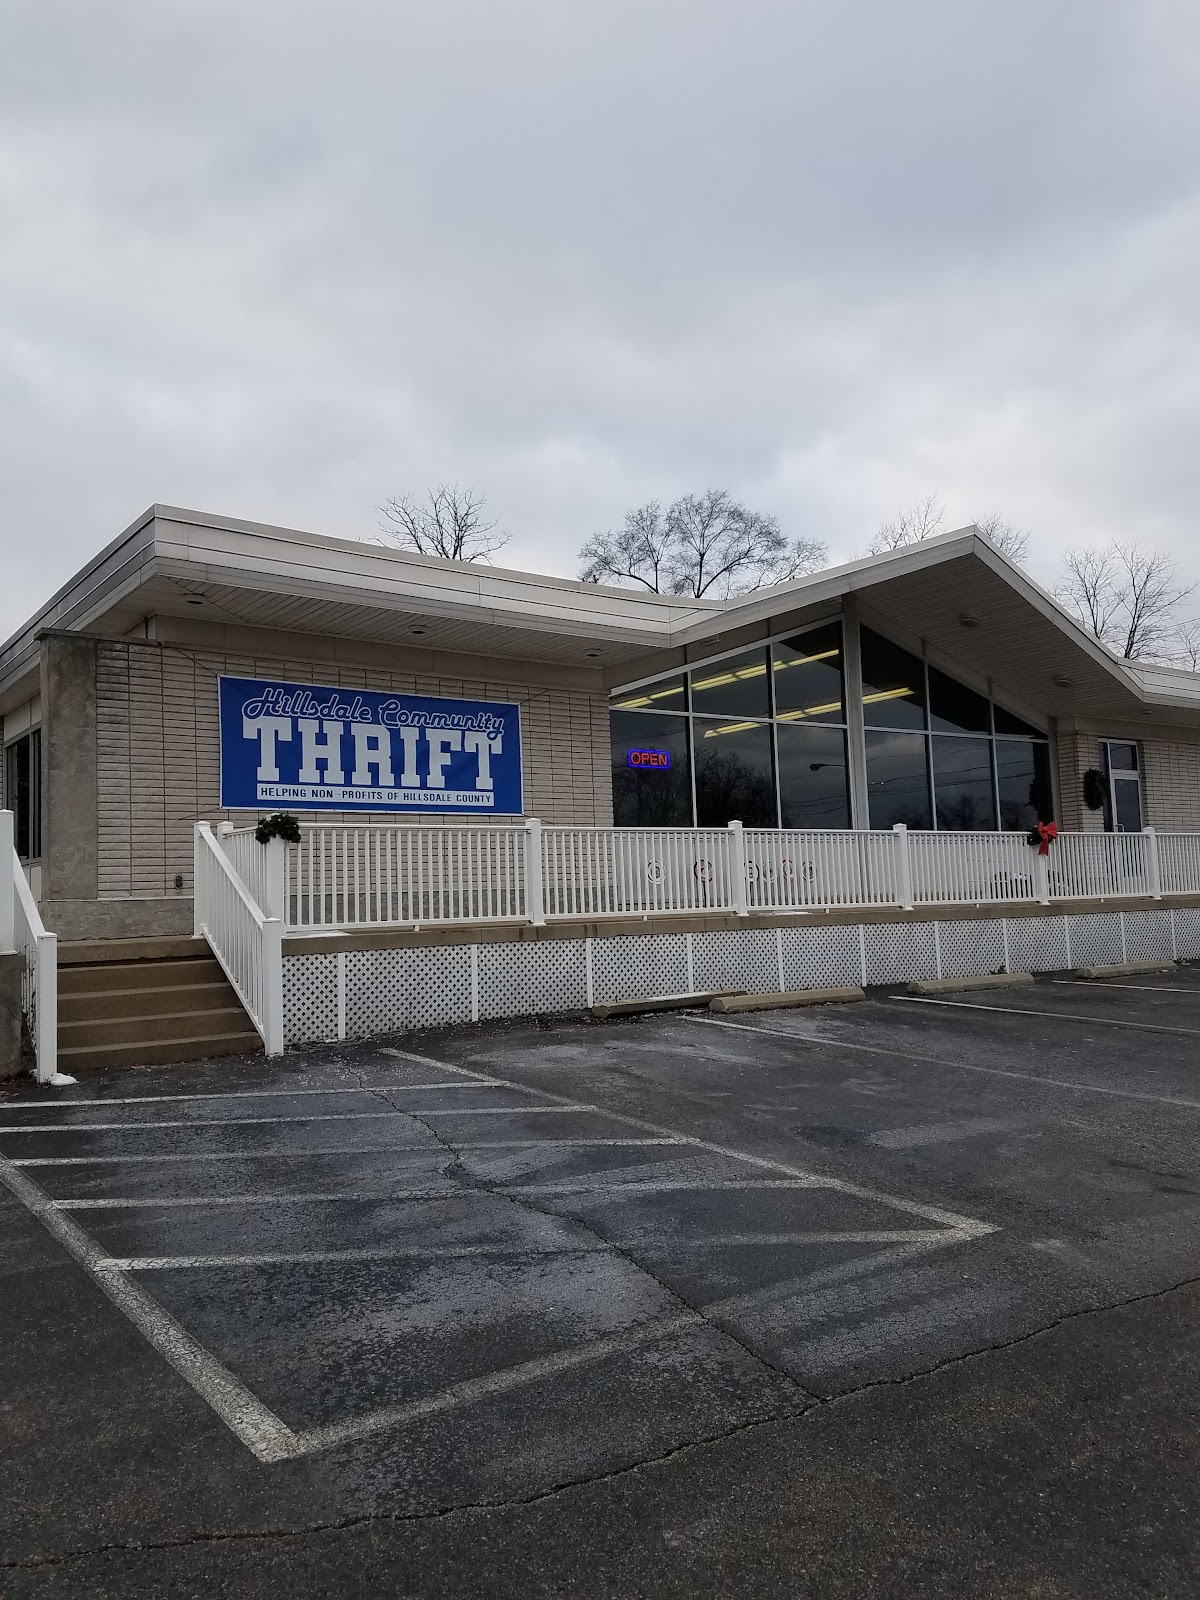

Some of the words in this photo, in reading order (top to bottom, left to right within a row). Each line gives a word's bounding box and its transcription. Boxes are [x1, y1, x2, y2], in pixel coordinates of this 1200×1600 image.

[242, 688, 371, 722] Hillsdale
[378, 700, 504, 740] Community
[243, 715, 503, 790] THRIFT
[630, 752, 668, 767] OPEN
[260, 787, 307, 798] HELPING
[387, 792, 400, 801] OF
[403, 793, 452, 803] HILLSDALE
[456, 794, 491, 804] COUNTY
